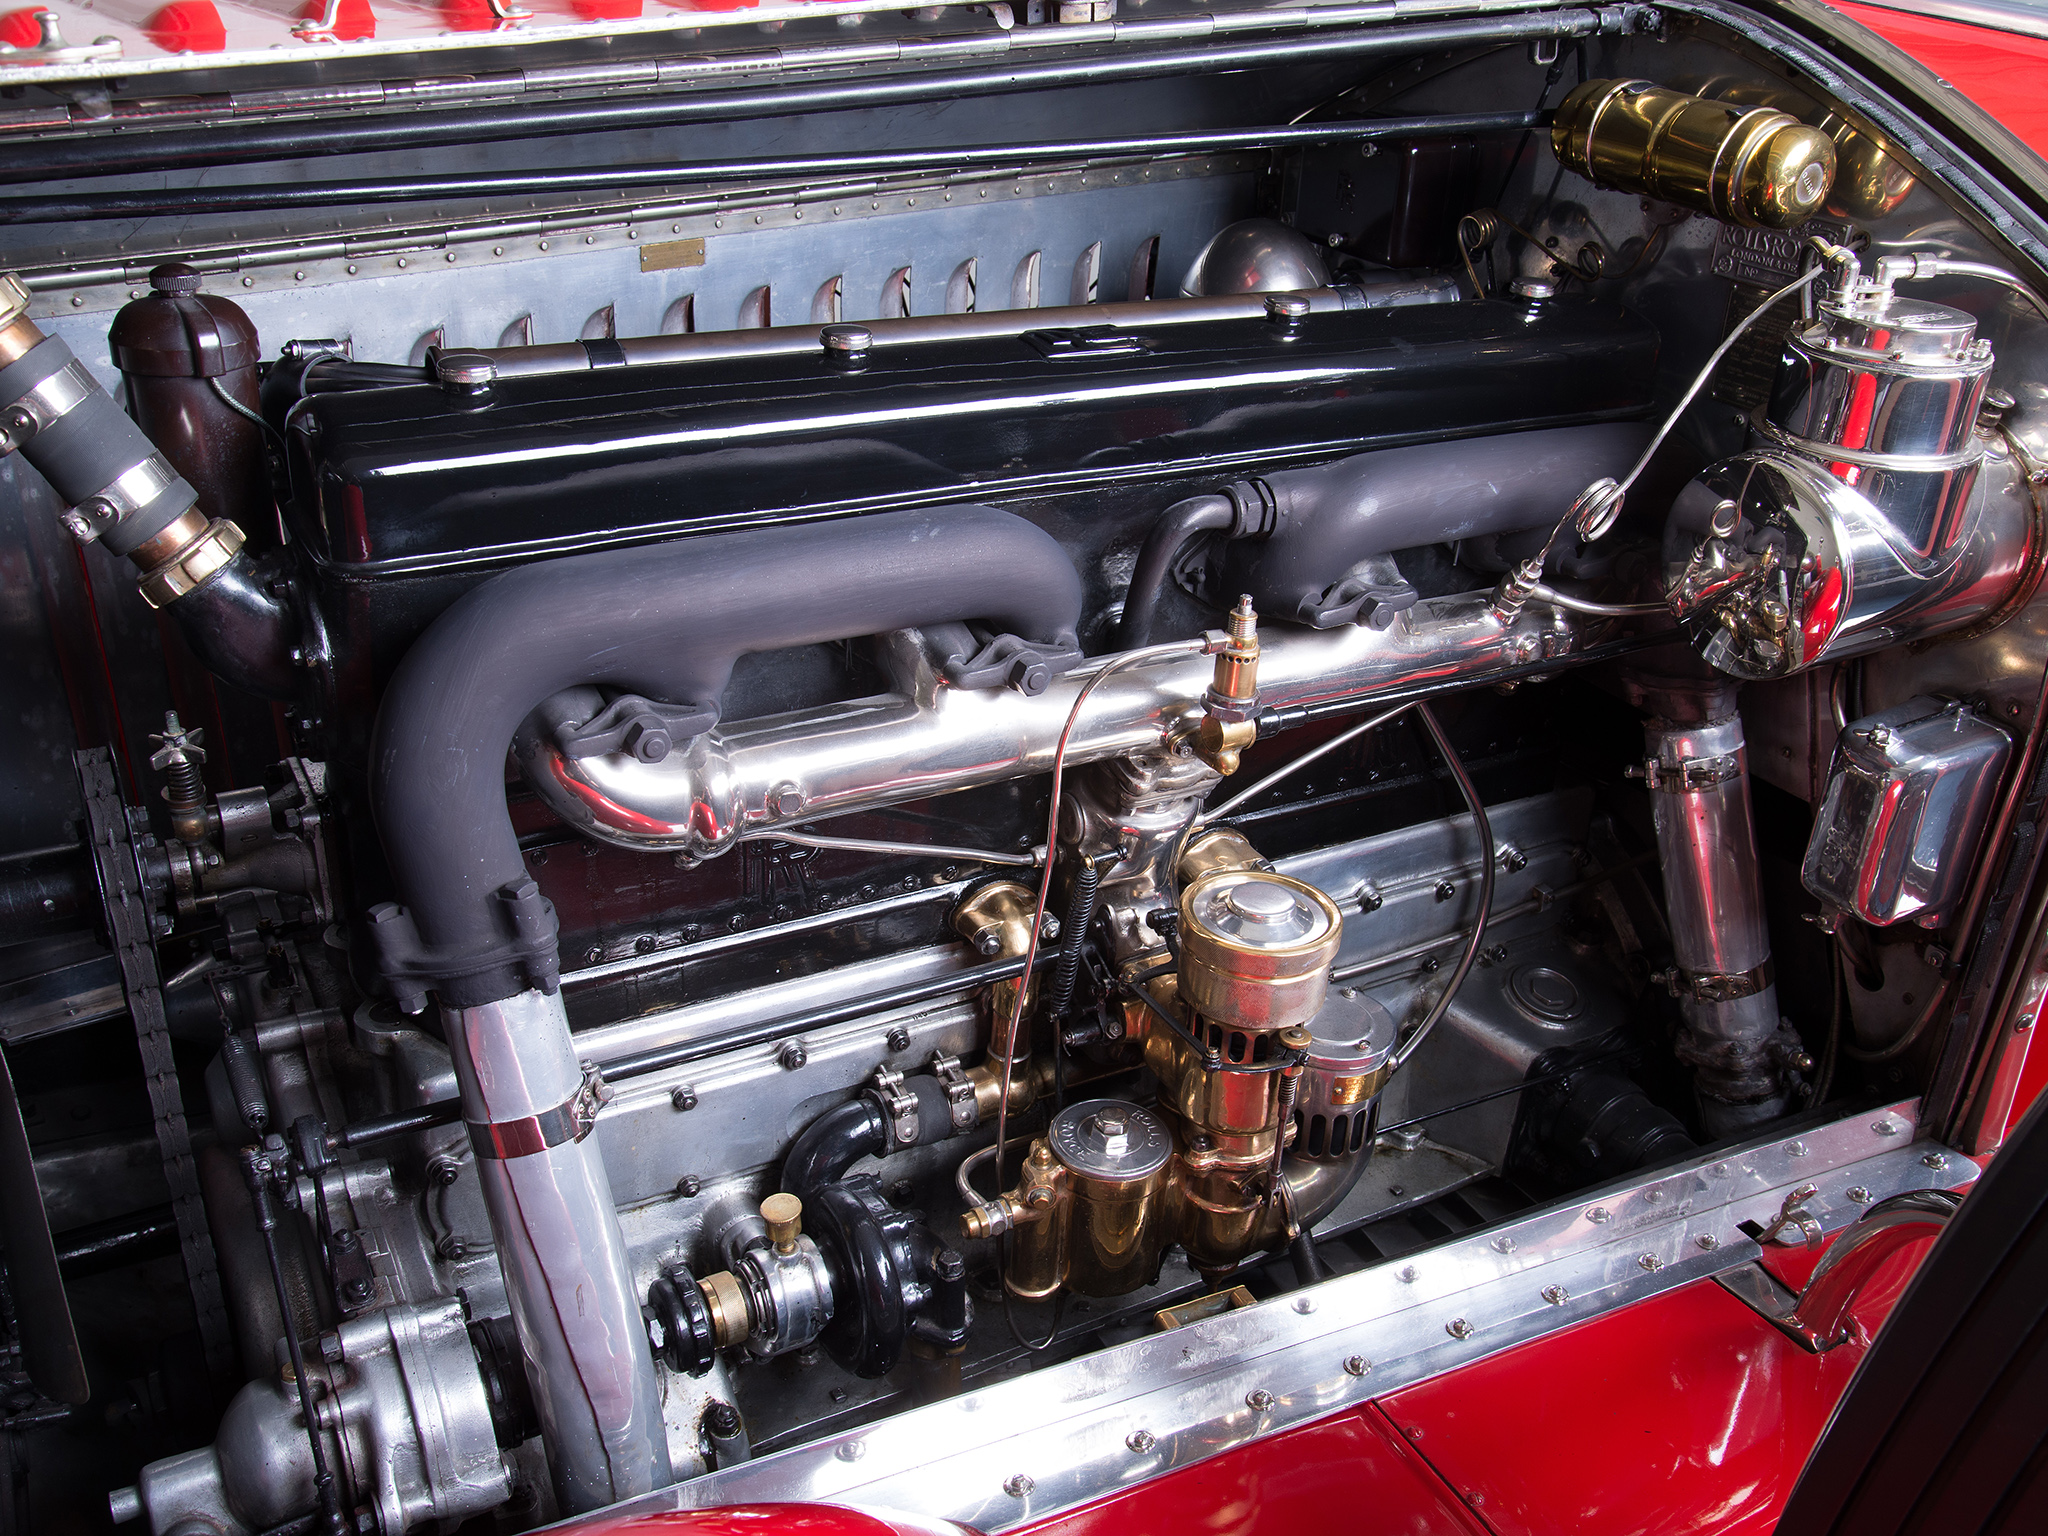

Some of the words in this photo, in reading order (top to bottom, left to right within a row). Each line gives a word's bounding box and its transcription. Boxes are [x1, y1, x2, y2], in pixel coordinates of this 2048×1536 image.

[1731, 248, 1774, 268] LONDON
[1775, 260, 1783, 270] &
[1059, 1119, 1091, 1161] ROYCE
[1131, 1109, 1161, 1148] ROLLS
